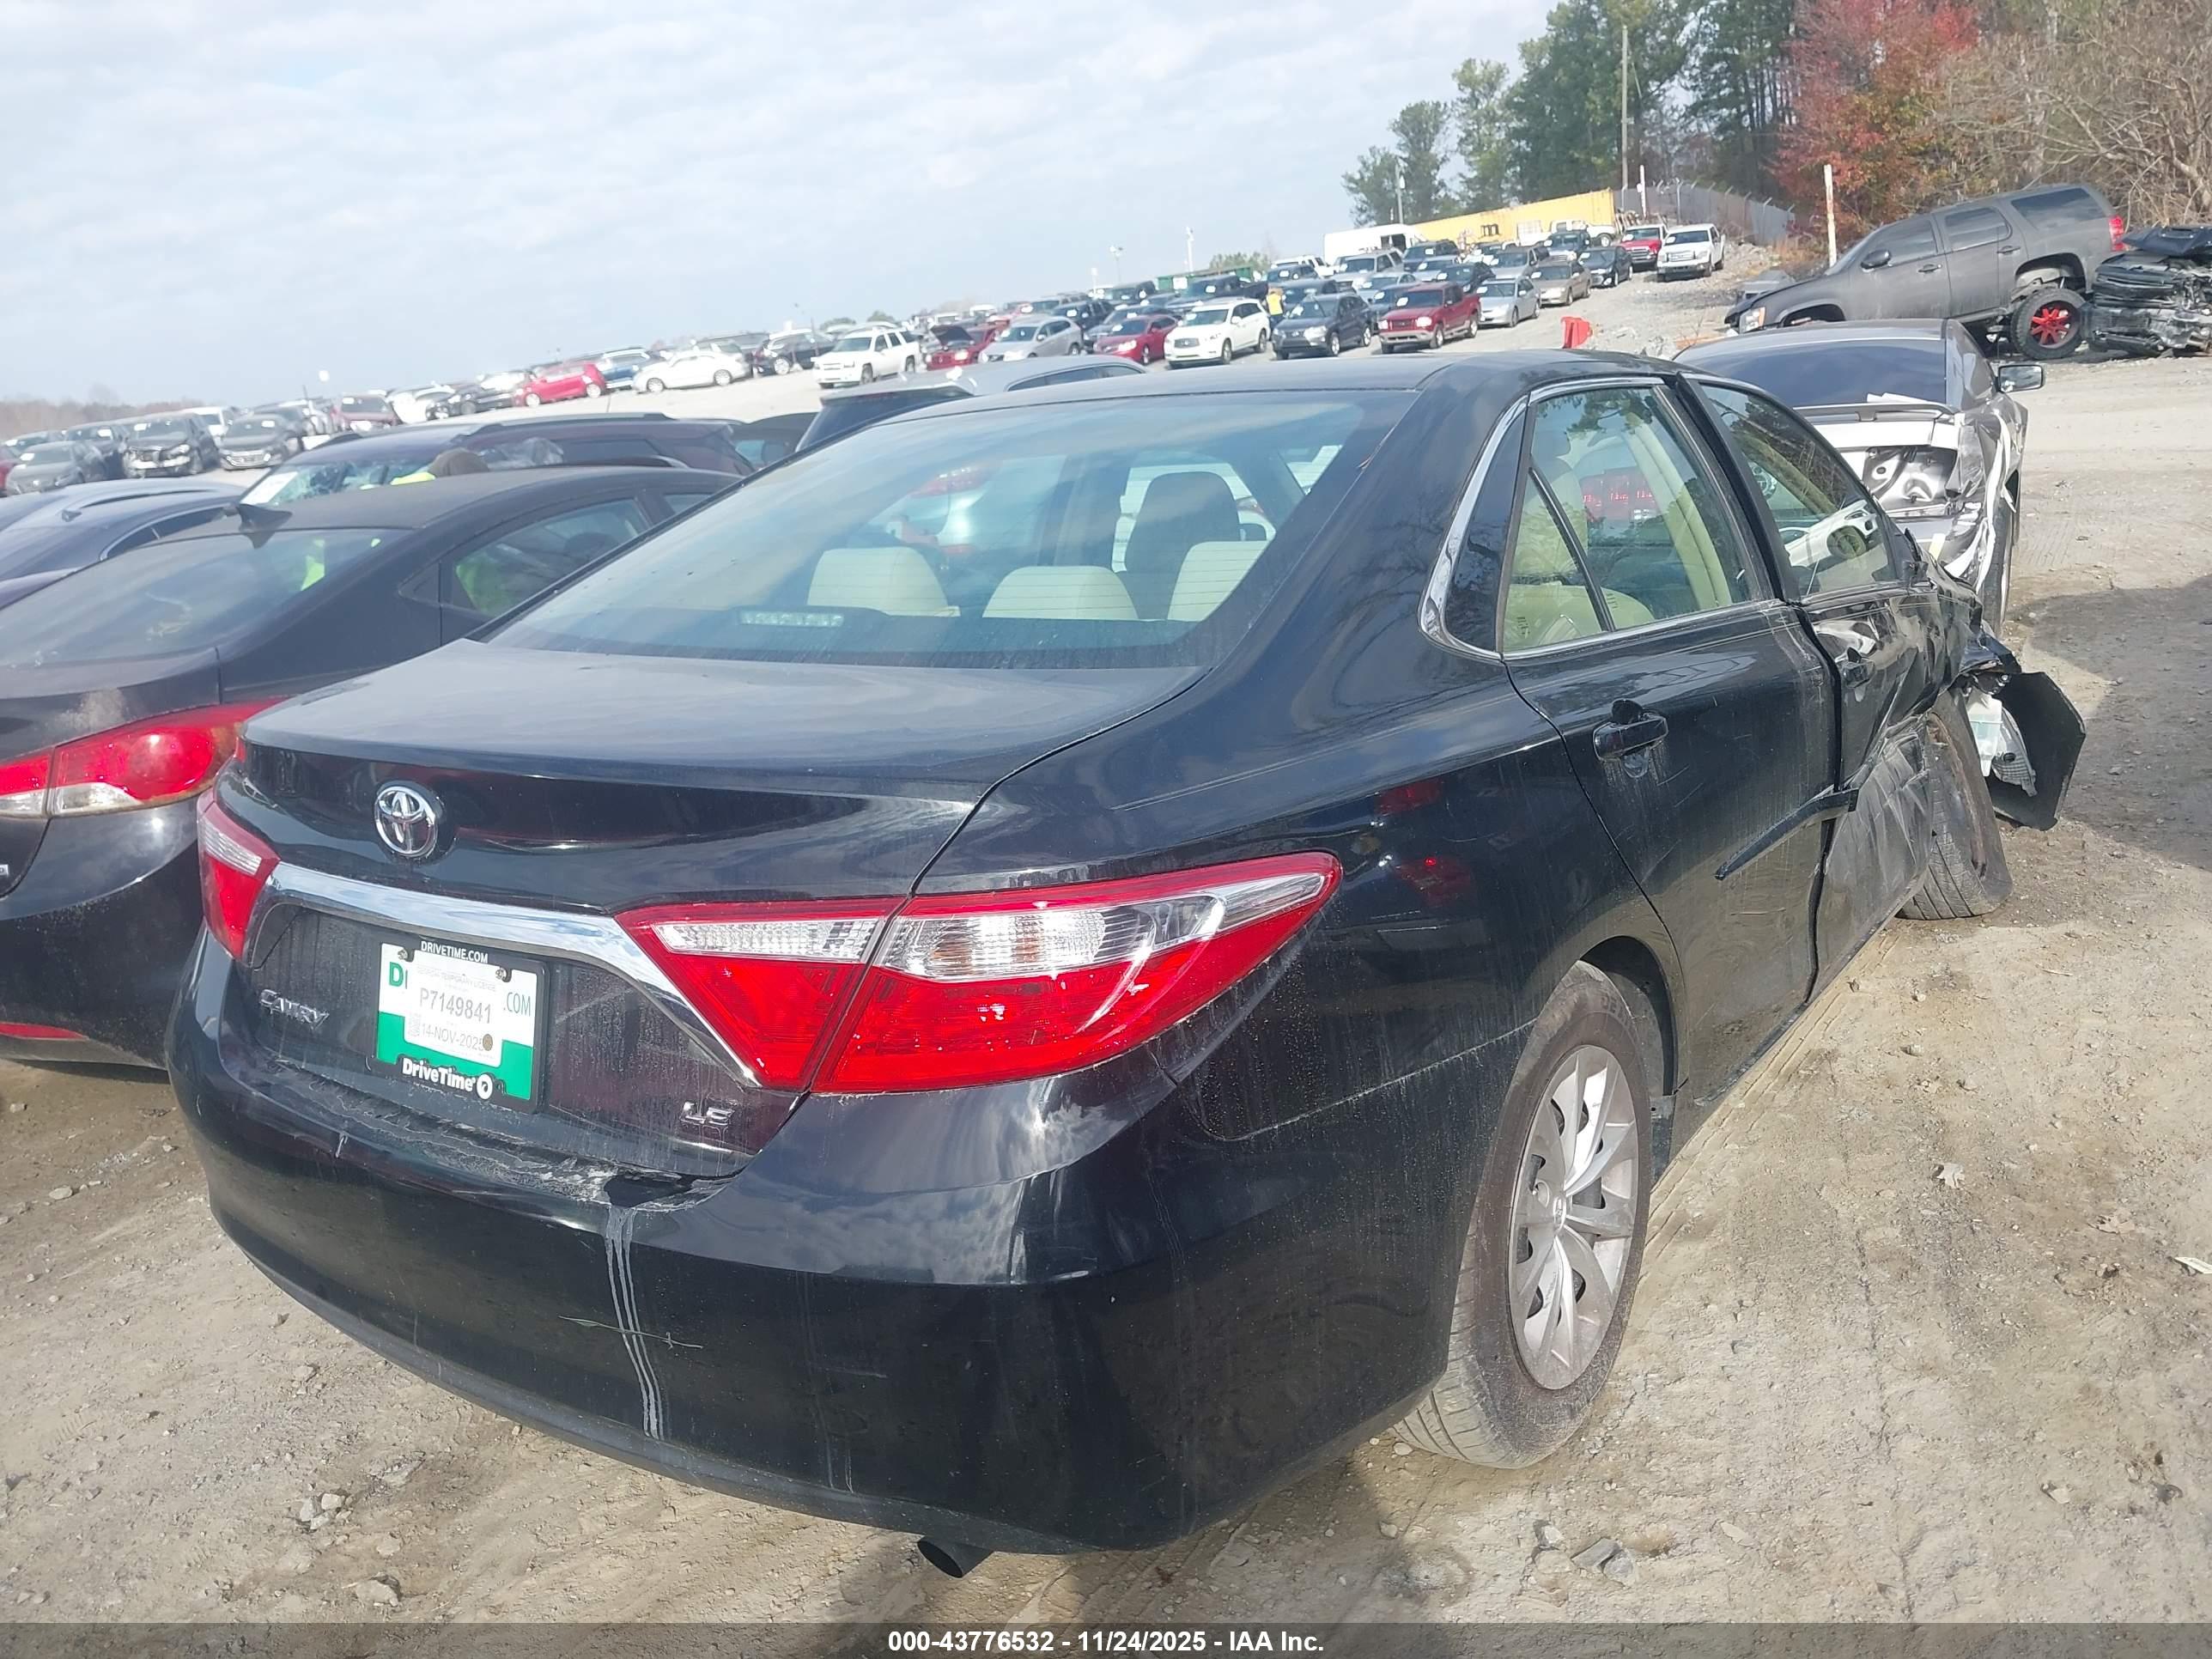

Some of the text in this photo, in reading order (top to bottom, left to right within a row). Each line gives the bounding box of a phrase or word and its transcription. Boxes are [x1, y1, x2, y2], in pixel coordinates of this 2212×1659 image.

[420, 940, 489, 964] DRIVETIME.COM
[420, 988, 491, 1024] P7149841
[402, 1057, 473, 1092] DriveTime
